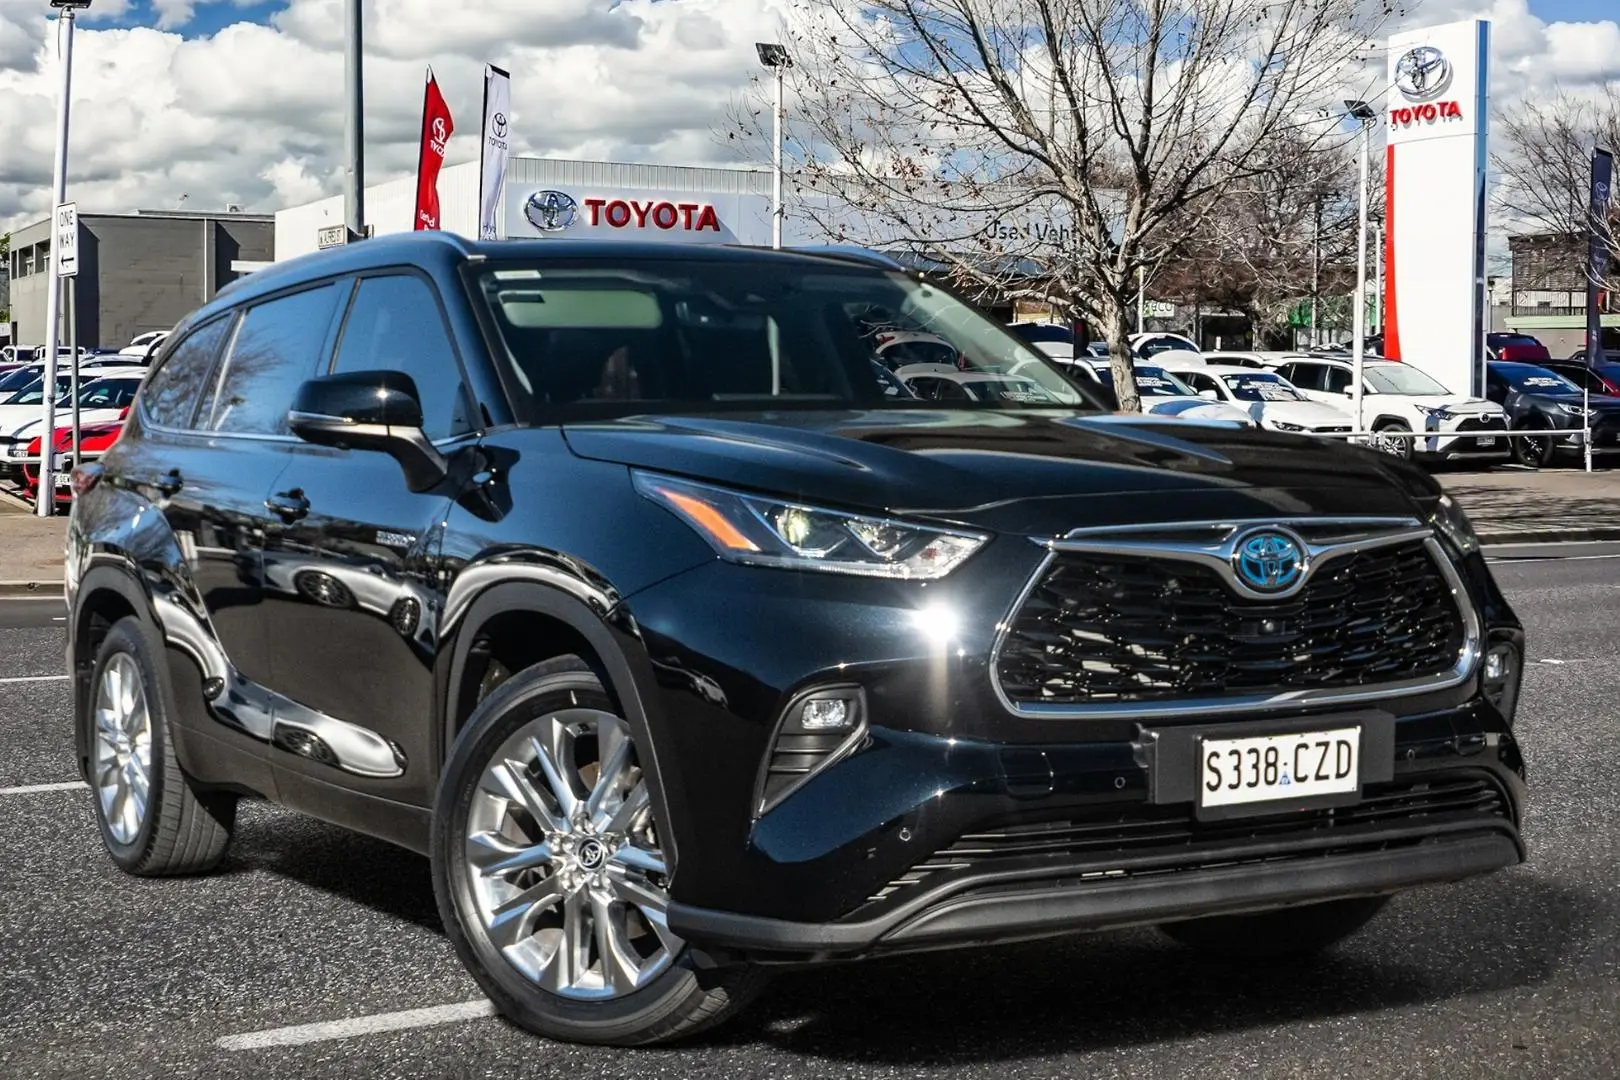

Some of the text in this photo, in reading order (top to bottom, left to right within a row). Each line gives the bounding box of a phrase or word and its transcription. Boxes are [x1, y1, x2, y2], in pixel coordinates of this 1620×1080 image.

[1390, 101, 1462, 125] TOYOTA
[488, 136, 508, 151] TOYOTA
[60, 210, 74, 227] ONE
[584, 198, 721, 232] TOYOTA
[60, 231, 75, 248] WAY
